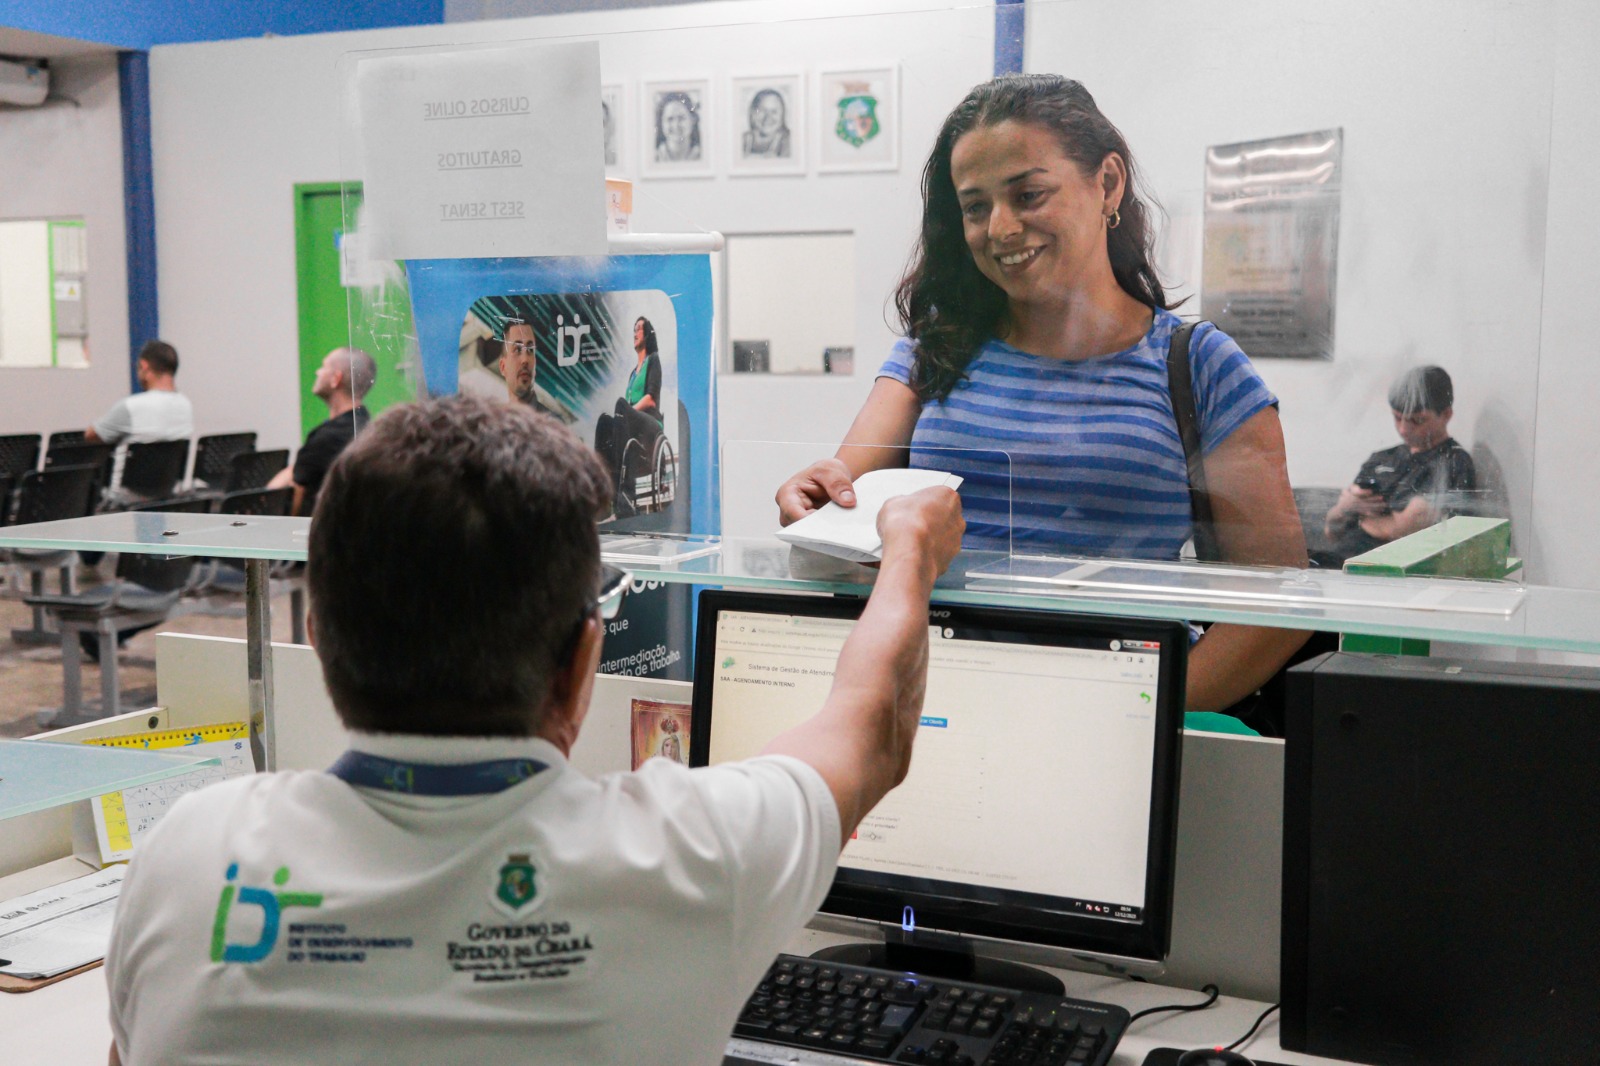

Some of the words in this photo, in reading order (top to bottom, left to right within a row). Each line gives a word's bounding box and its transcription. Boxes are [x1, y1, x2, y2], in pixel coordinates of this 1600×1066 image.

[609, 619, 629, 635] que
[598, 644, 667, 674] intermediação
[634, 663, 648, 676] de
[748, 664, 770, 672] Sistema
[780, 666, 800, 674] Gestão
[733, 676, 772, 686] AGENDAMENTO
[447, 942, 510, 960] ESTADO
